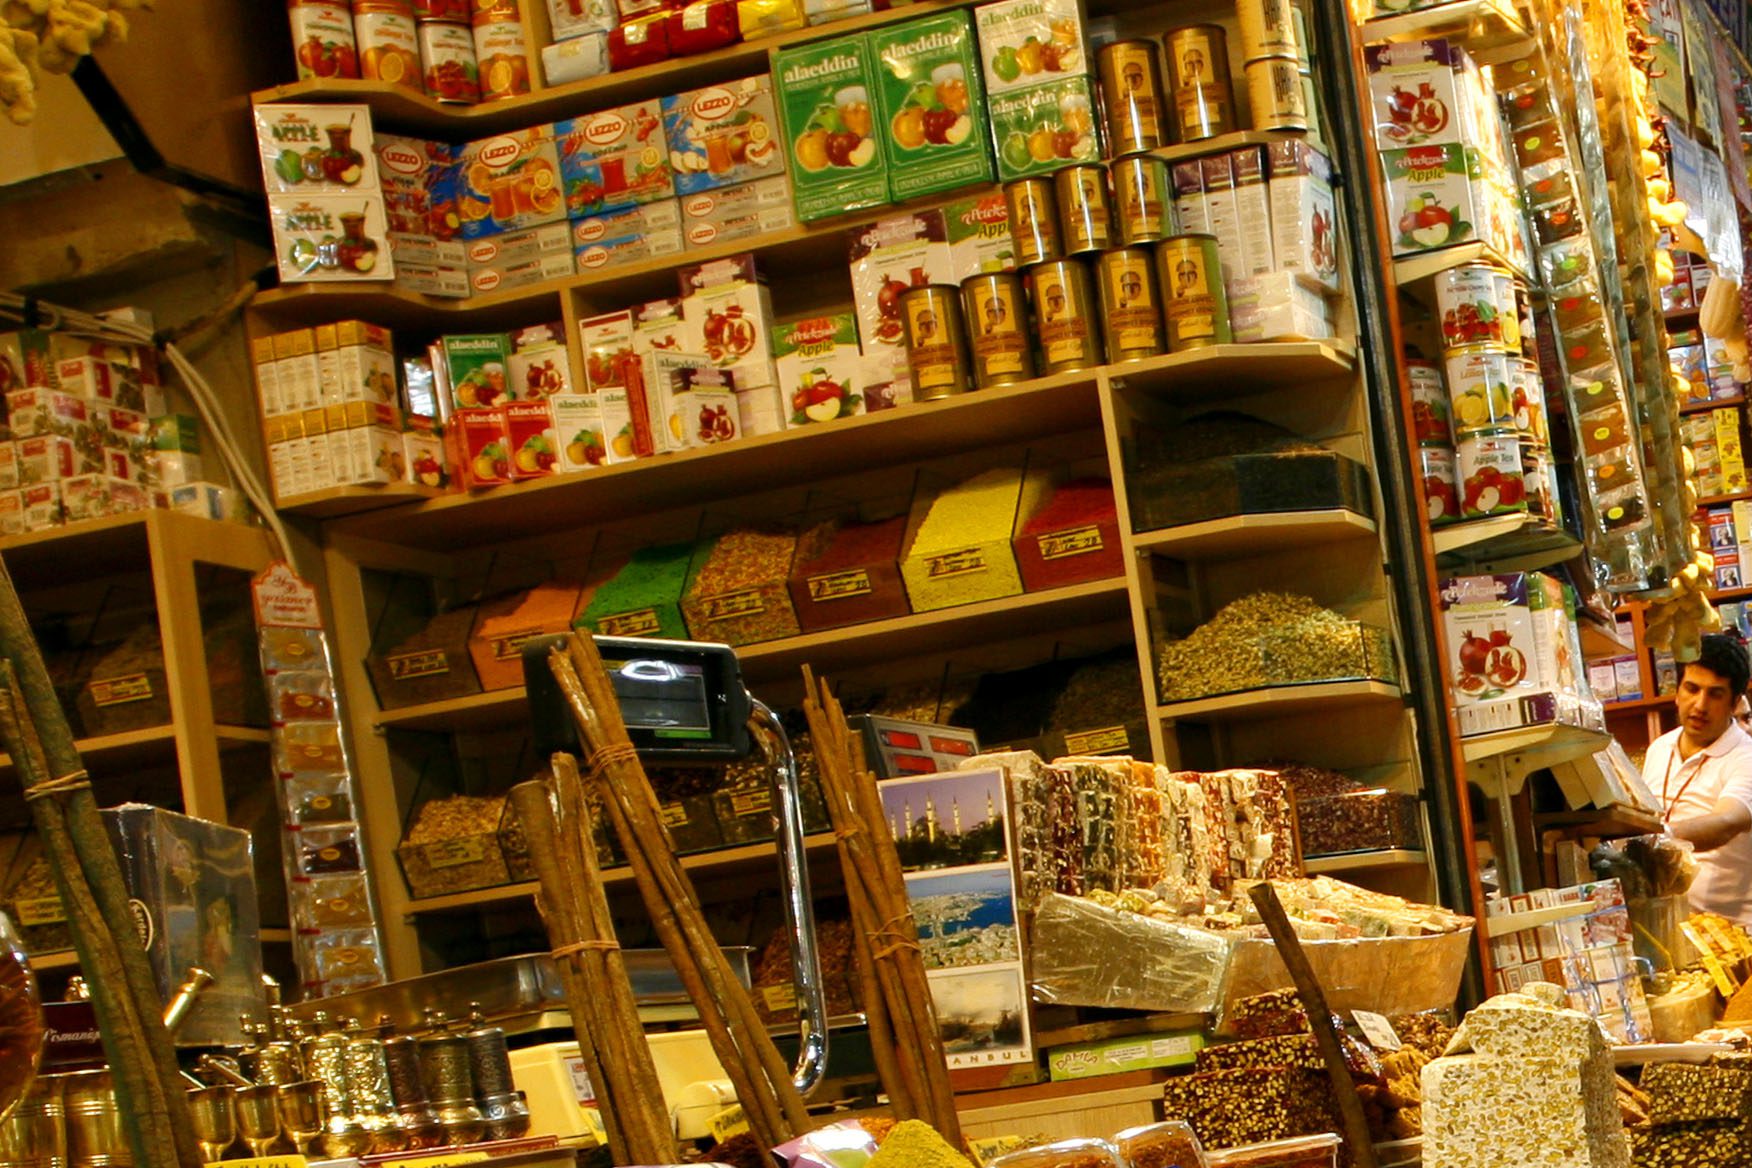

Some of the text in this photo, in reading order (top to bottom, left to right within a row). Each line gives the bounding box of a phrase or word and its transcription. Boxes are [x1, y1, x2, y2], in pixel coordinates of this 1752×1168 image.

[784, 54, 859, 83] alaeddin
[697, 96, 732, 111] LEZZO
[588, 121, 623, 137] LEZZO
[385, 151, 420, 168] LEZZO
[483, 144, 517, 160] LEZZO
[1408, 168, 1444, 182] Apple
[798, 341, 834, 357] Apple
[1473, 452, 1498, 466] Apple
[953, 1051, 1028, 1066] ANBUL
